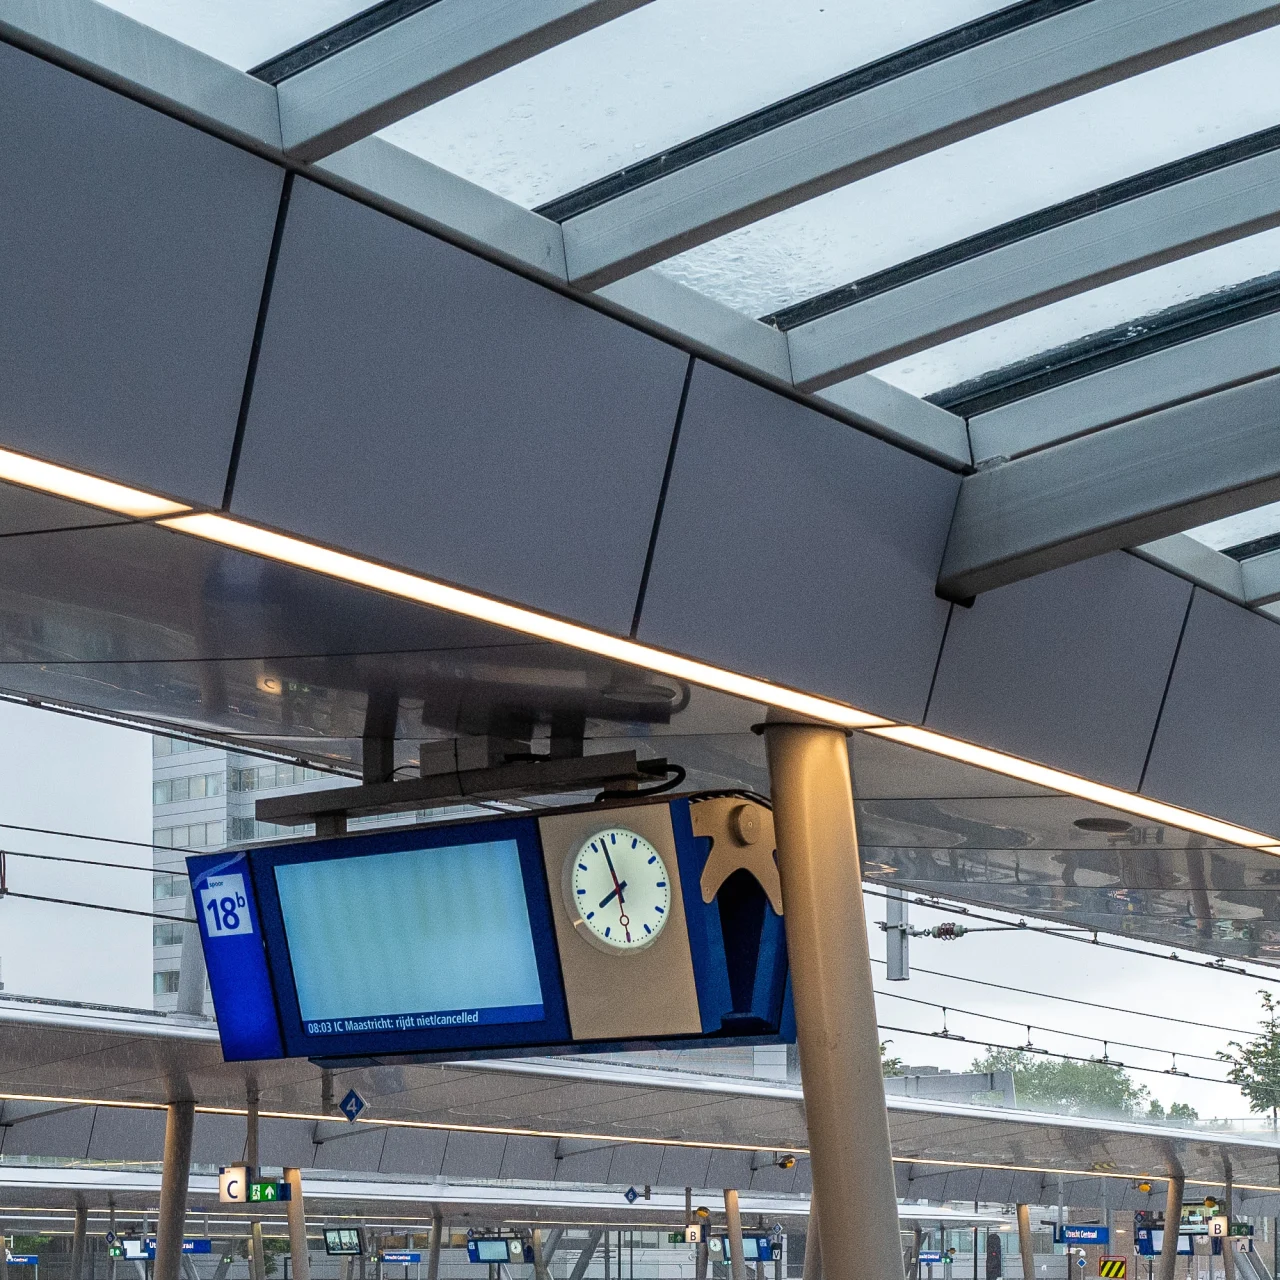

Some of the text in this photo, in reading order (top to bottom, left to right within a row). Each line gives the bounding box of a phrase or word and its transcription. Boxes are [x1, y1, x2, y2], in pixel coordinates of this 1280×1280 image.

[308, 1022, 332, 1034] 08:03
[334, 1021, 343, 1032] IC
[345, 1017, 394, 1031] Maastricht:
[396, 1015, 415, 1031] rijdt
[346, 1097, 357, 1114] 4
[227, 1180, 238, 1199] C
[1065, 1230, 1080, 1238] Utrecht
[1214, 1224, 1222, 1235] B
[690, 1231, 696, 1241] B
[1240, 1243, 1246, 1252] A
[773, 1250, 780, 1259] V
